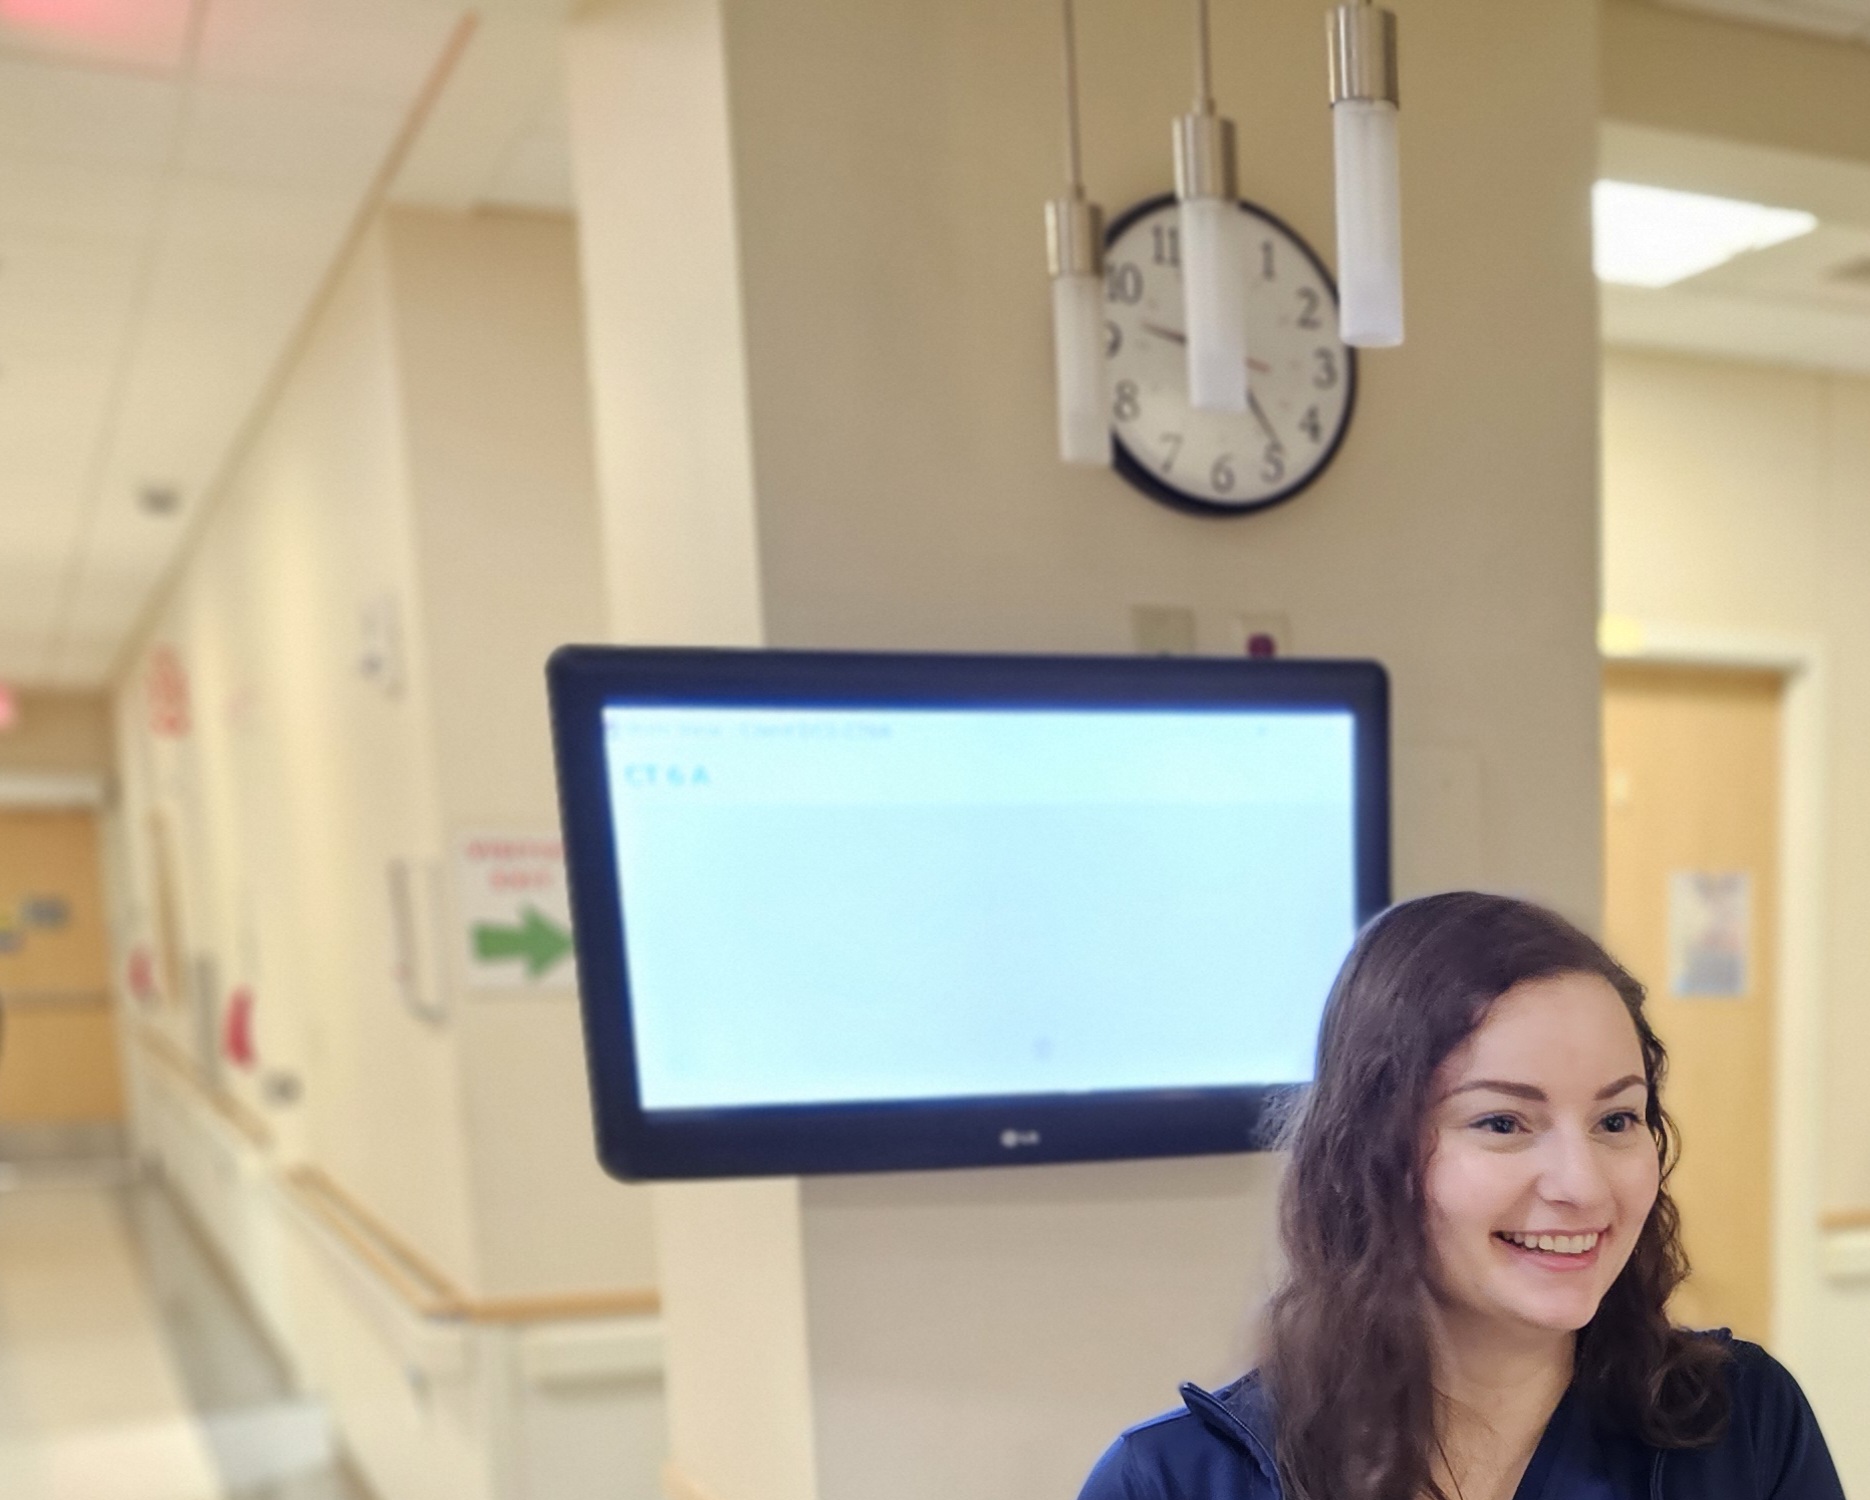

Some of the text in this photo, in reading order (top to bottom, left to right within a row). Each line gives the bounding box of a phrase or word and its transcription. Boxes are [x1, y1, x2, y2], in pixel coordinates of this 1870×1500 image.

[1261, 240, 1276, 281] 1
[1296, 285, 1322, 330] 2
[1312, 346, 1338, 391] 3
[1112, 378, 1141, 422] 8
[1299, 405, 1322, 443] 4
[1158, 432, 1184, 474] 7
[1210, 453, 1236, 494] 6
[1259, 441, 1285, 484] 5
